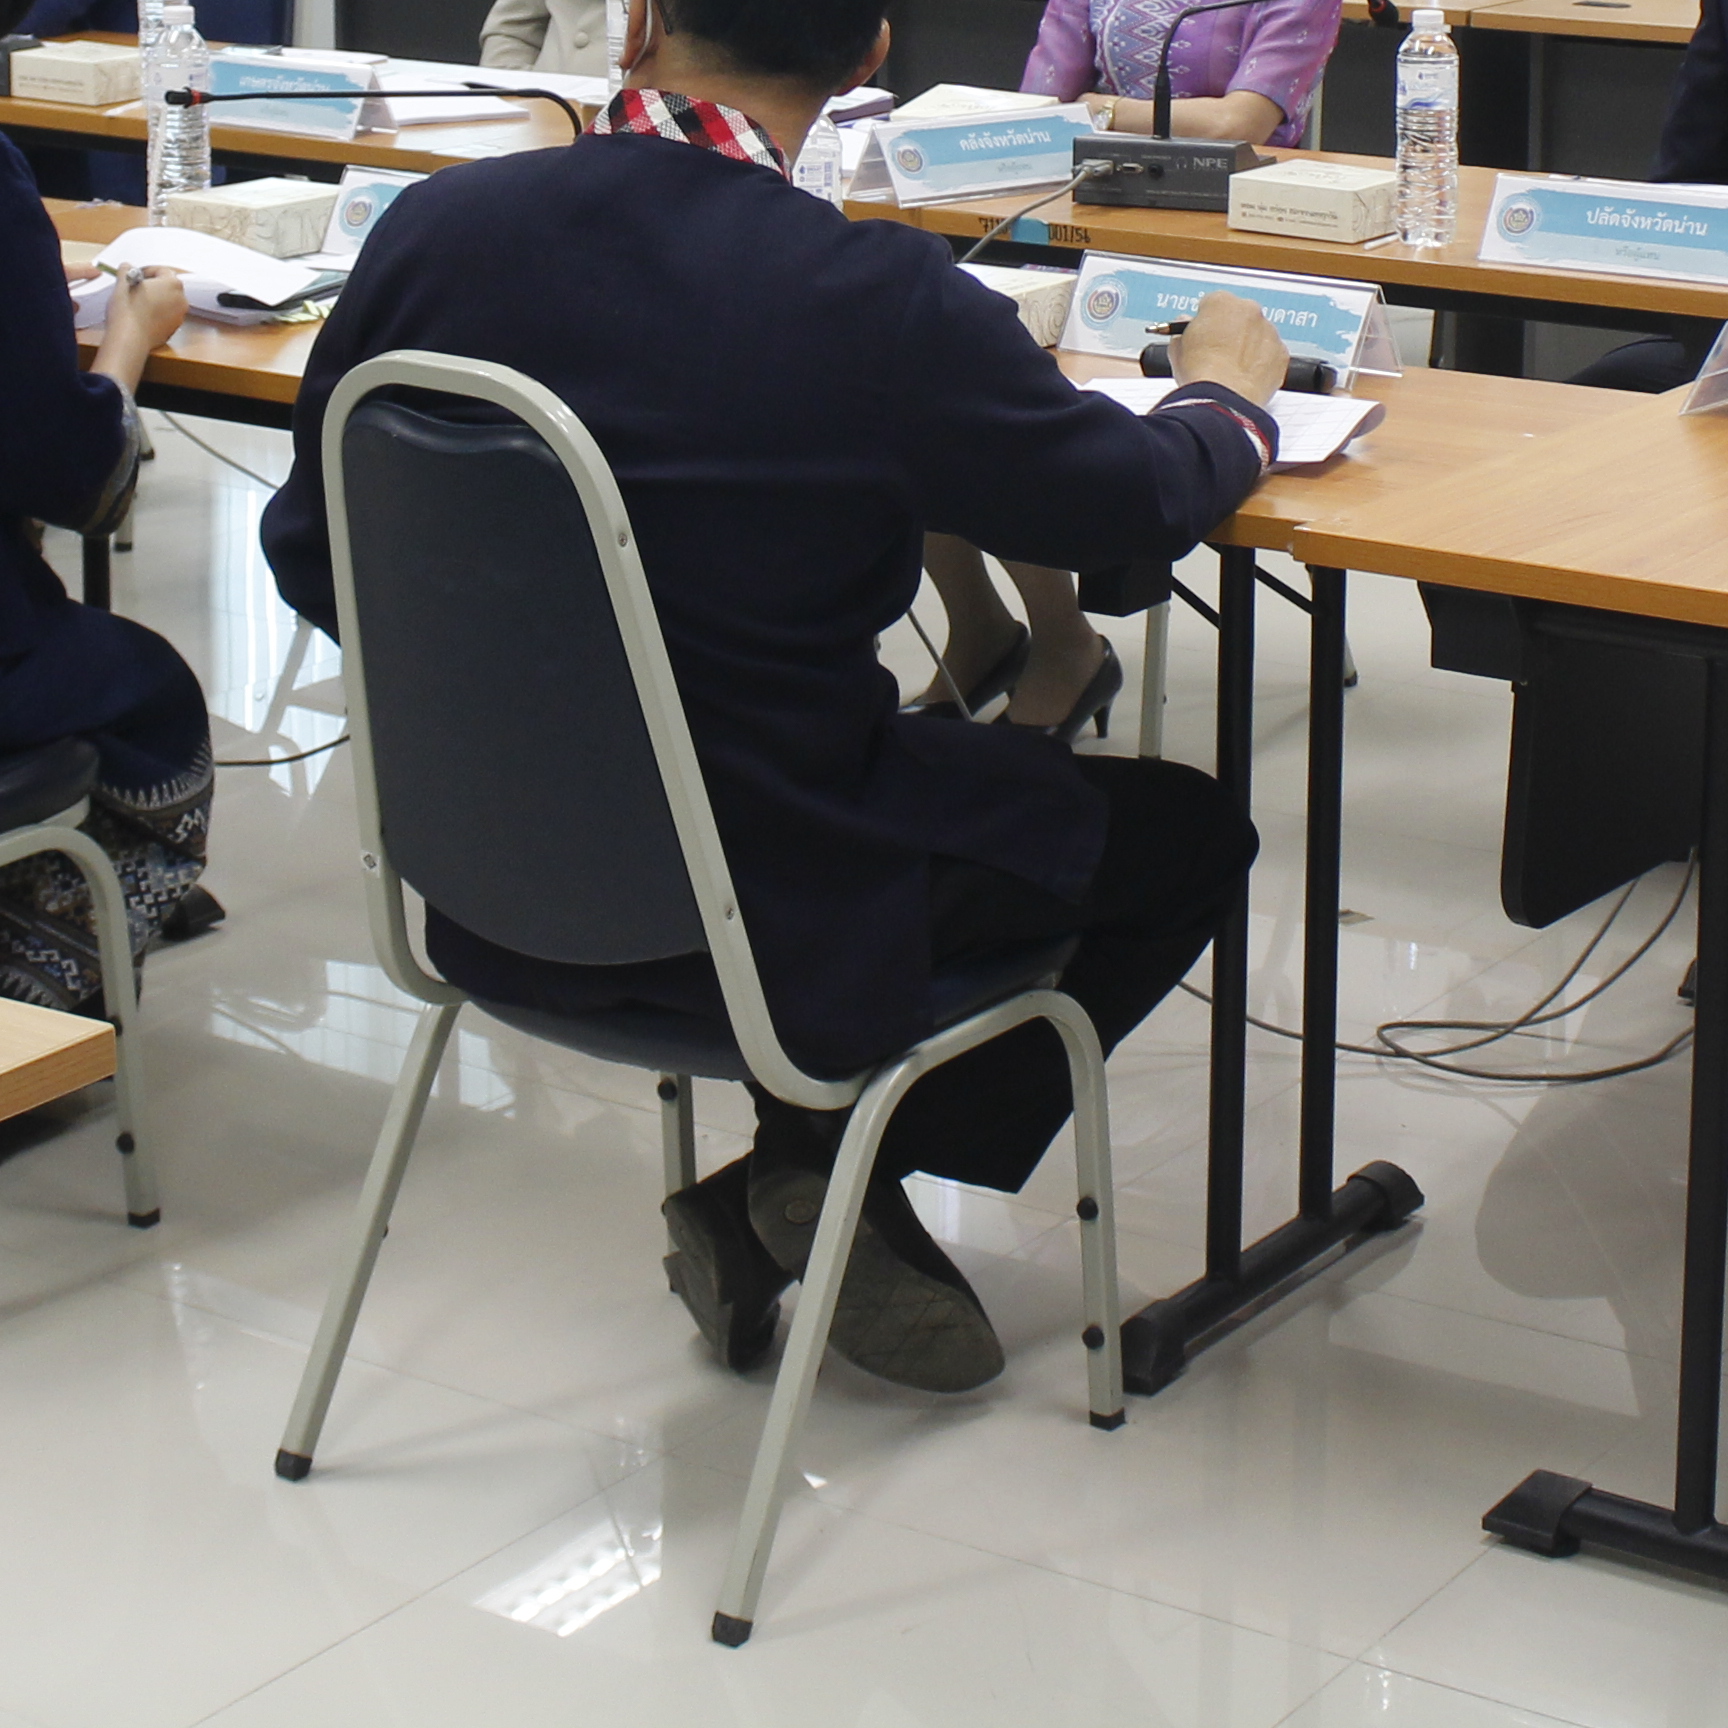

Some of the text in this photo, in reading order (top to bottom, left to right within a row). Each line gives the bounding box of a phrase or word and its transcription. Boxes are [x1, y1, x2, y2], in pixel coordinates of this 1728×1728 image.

[959, 129, 1052, 152] คลังจังหวัดน่าน
[1192, 156, 1229, 170] NPE
[1586, 205, 1708, 237] ปลัดจังหวัดน่าน
